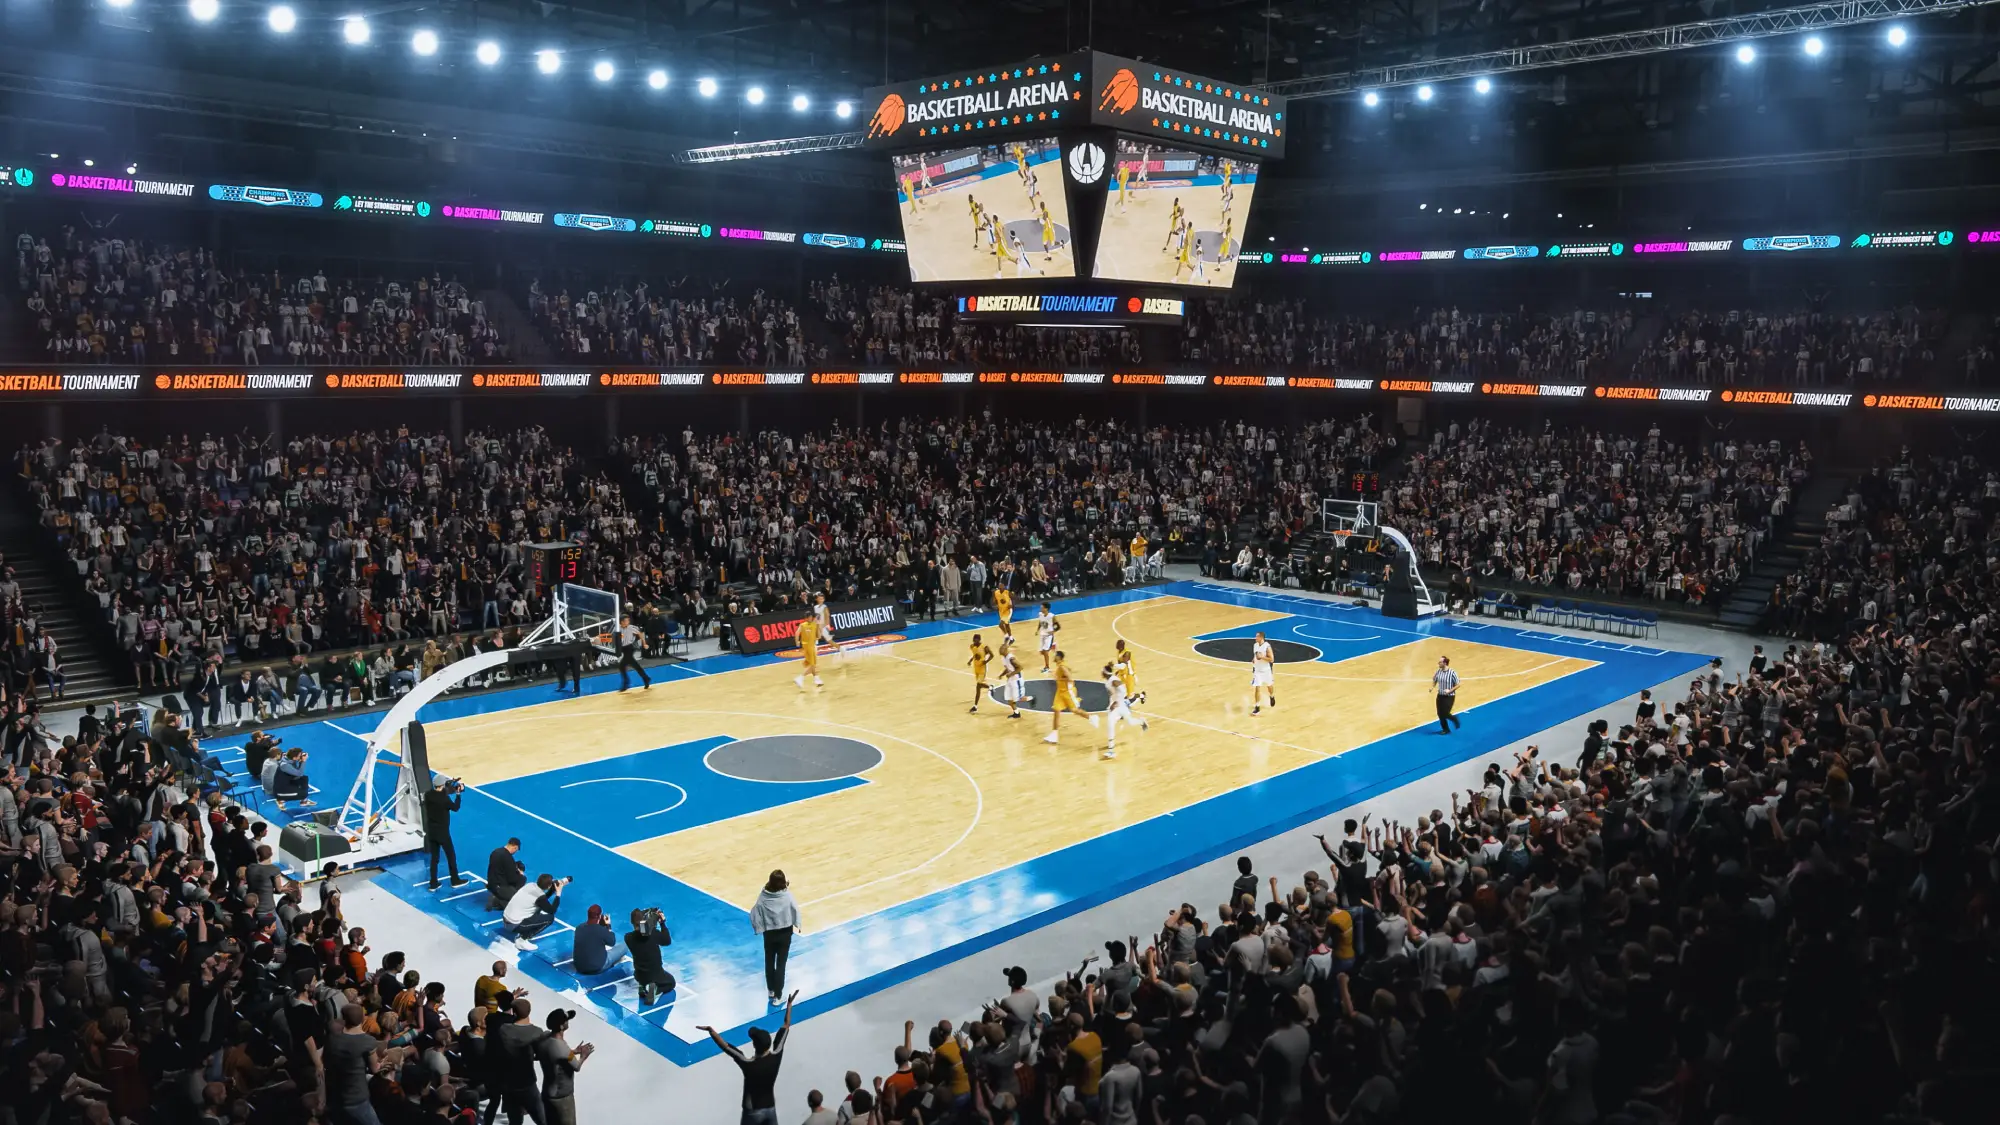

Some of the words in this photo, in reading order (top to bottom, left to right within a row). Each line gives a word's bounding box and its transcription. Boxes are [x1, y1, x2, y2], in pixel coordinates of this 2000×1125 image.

[907, 92, 1004, 123] BASKETBALL
[1007, 81, 1068, 109] ARENA
[1142, 88, 1226, 124] BASKETBALL
[1229, 107, 1273, 135] ARENA
[561, 562, 577, 578] 13
[831, 605, 895, 630] TOURNAMENT
